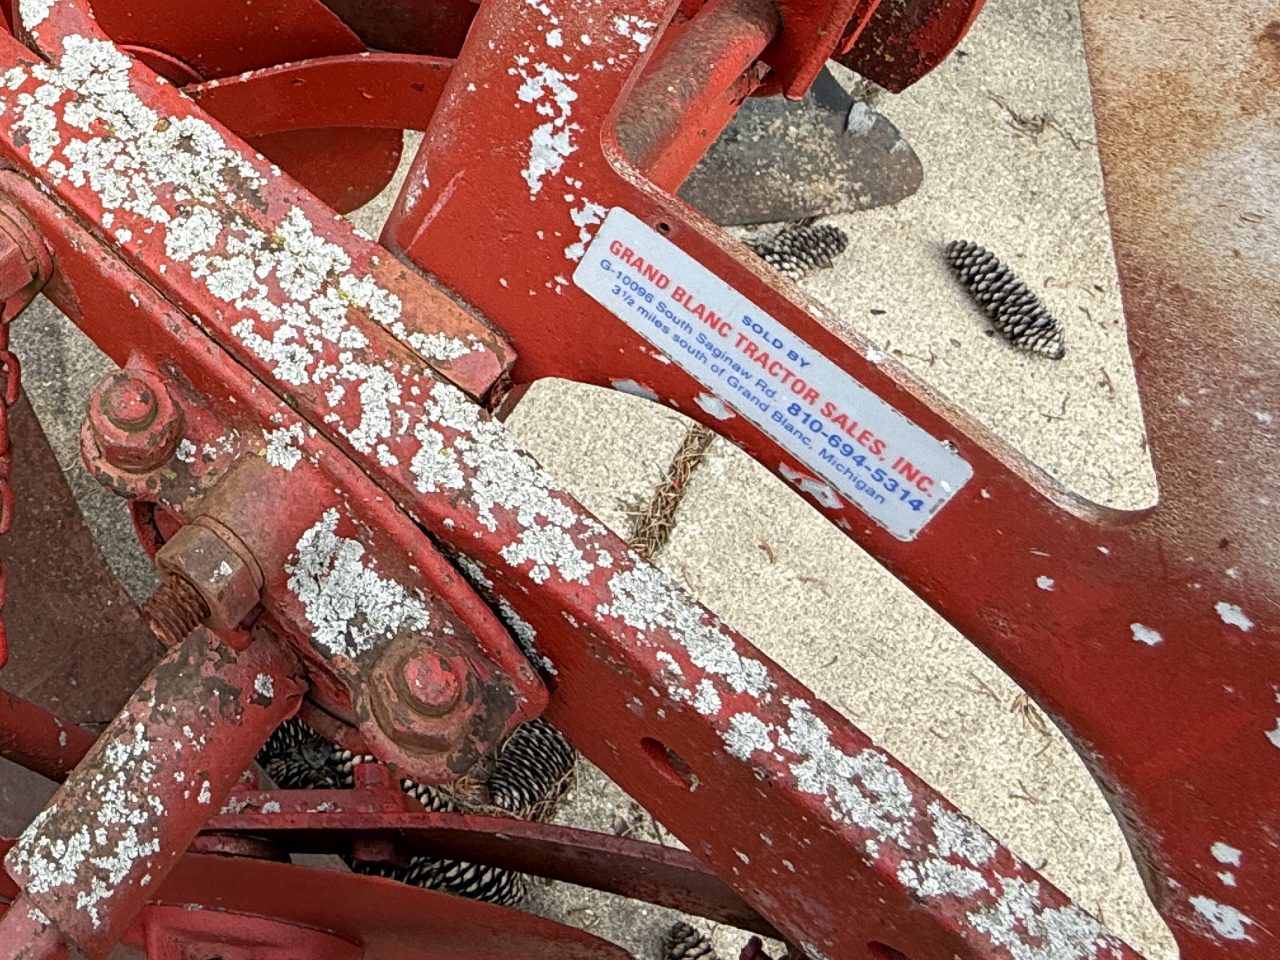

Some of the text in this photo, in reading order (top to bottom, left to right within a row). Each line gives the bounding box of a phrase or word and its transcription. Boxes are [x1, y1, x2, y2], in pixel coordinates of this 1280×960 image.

[600, 259, 655, 304] G-10096
[656, 301, 694, 335] South
[695, 332, 753, 380] Saginaw
[787, 402, 924, 511] 810-694-5314
[609, 239, 935, 498] GRAND BLANC TRACTOR SALES, INC.
[636, 306, 670, 335] miles
[671, 333, 708, 364] south
[710, 363, 726, 377] of
[726, 376, 770, 412] Grand
[771, 410, 813, 450] Blanc,
[818, 447, 886, 505] Michigan
[741, 315, 811, 368] SOLD BY
